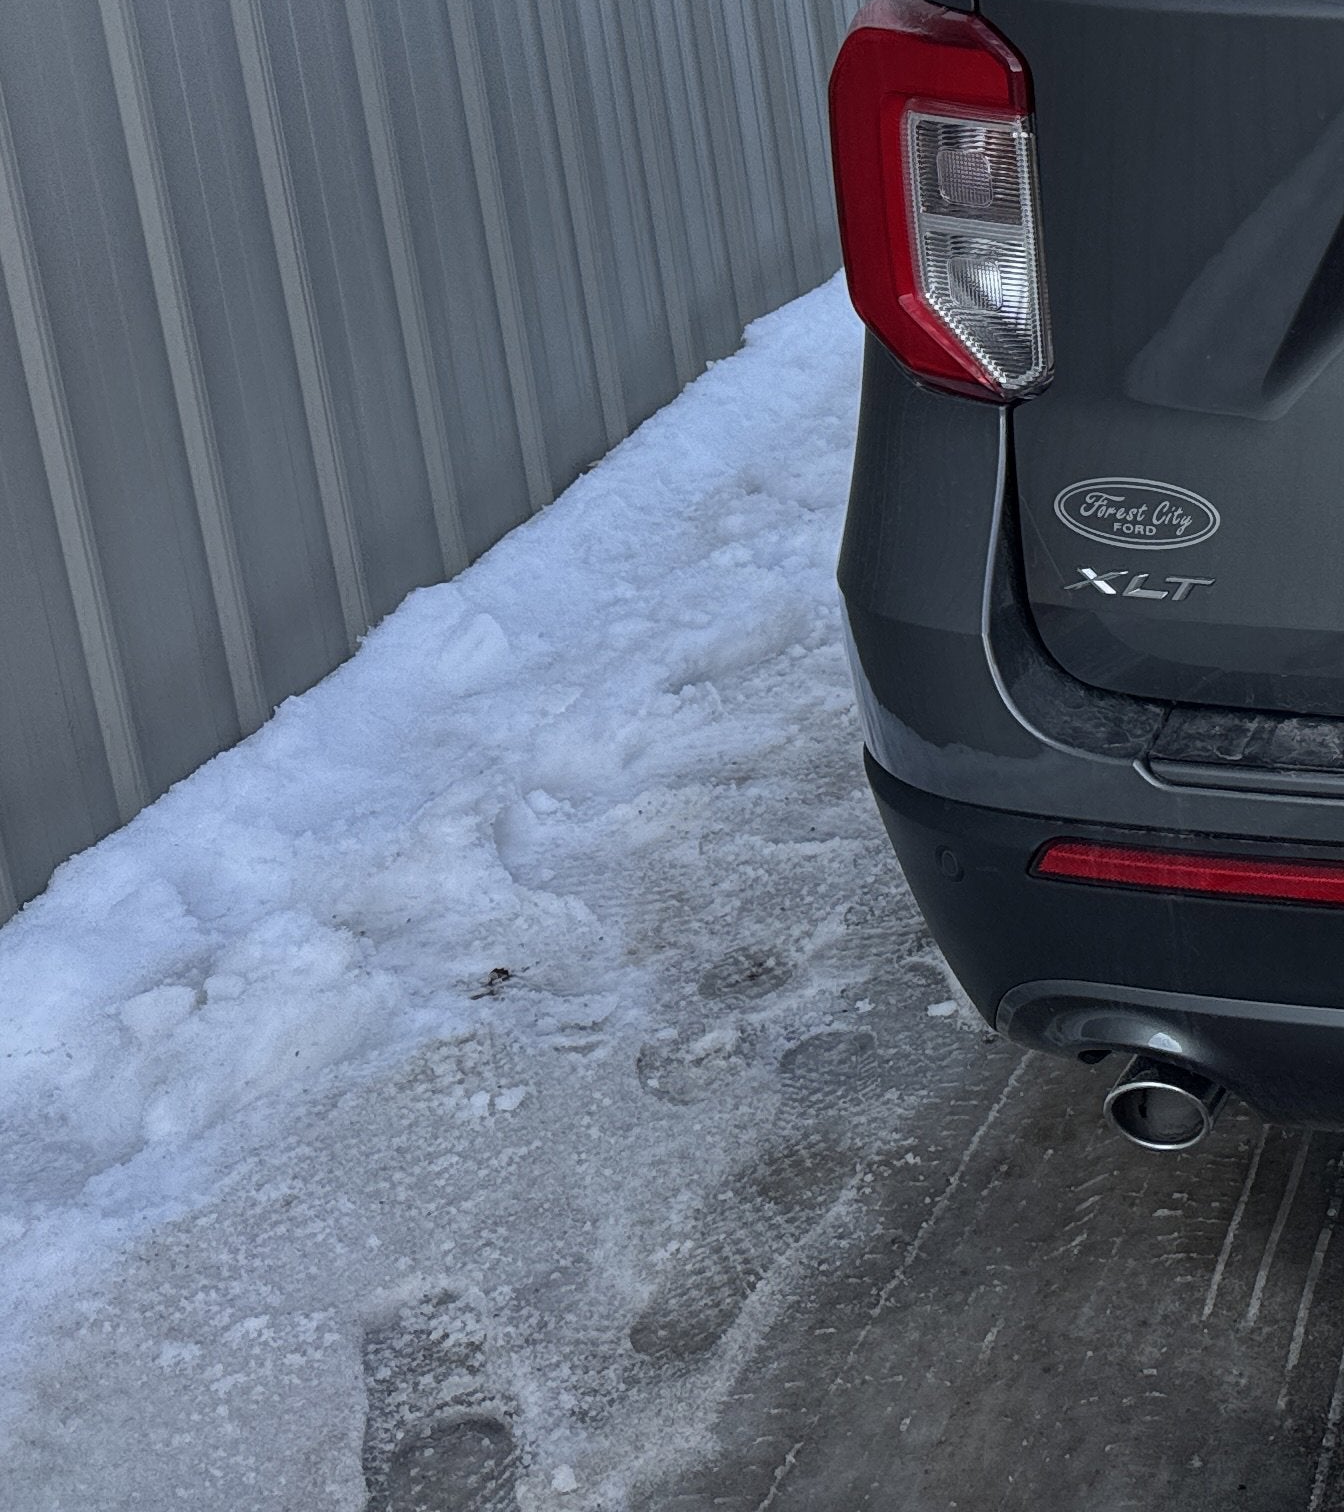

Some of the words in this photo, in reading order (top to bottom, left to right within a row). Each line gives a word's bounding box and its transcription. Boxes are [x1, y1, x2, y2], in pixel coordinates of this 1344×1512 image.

[1079, 491, 1149, 522] Forest
[1152, 500, 1192, 536] City
[1113, 522, 1157, 536] FORD
[1064, 567, 1216, 600] XLT
